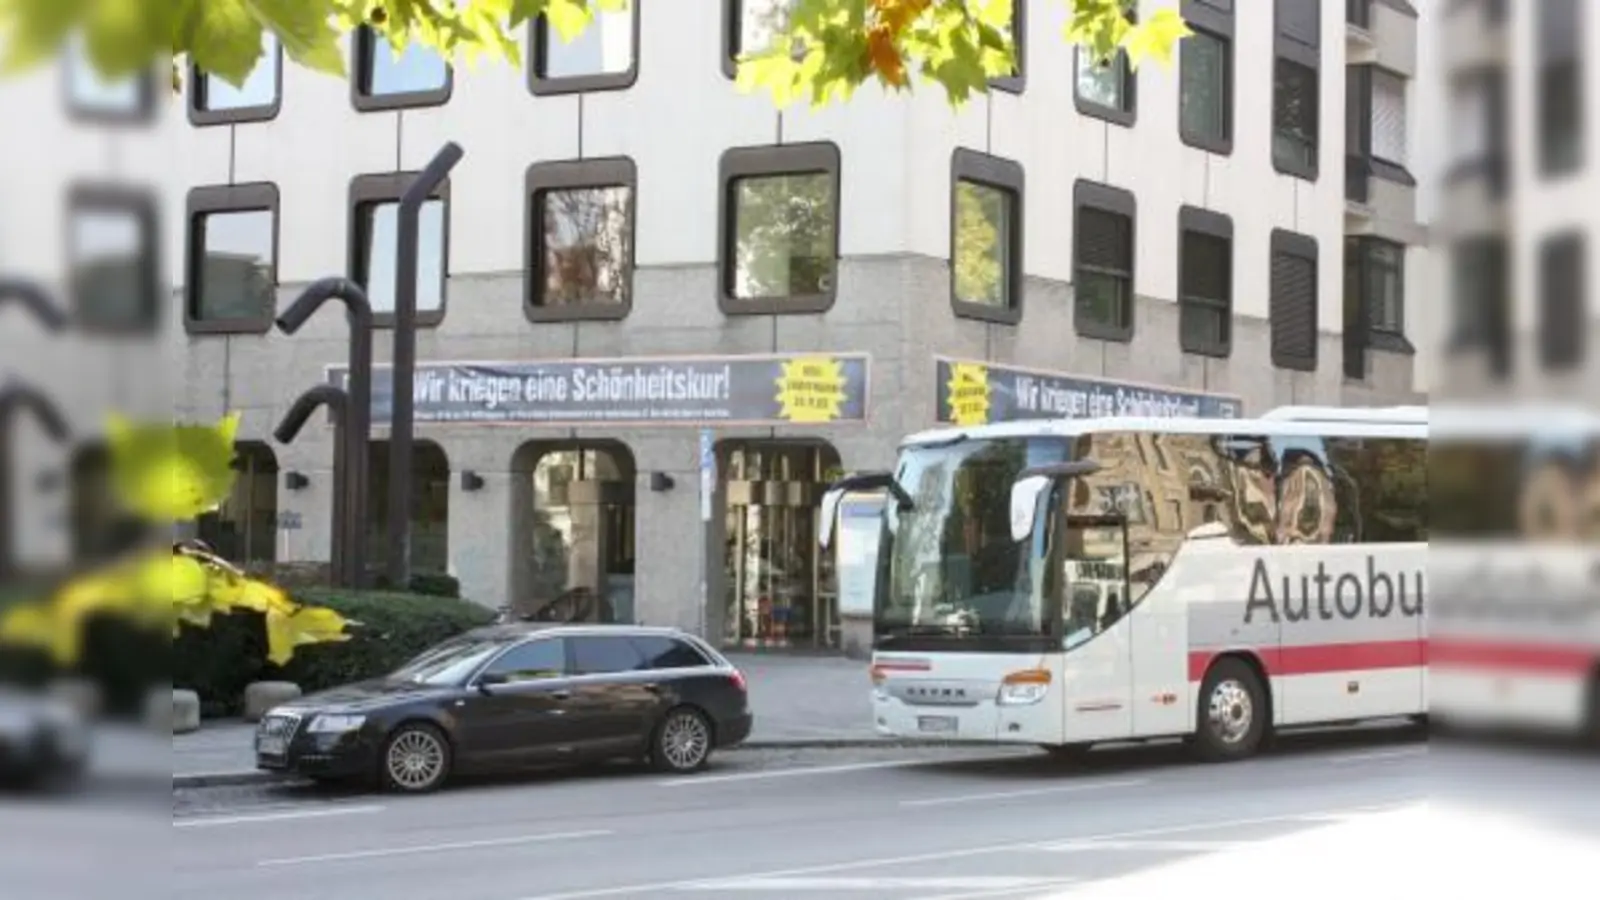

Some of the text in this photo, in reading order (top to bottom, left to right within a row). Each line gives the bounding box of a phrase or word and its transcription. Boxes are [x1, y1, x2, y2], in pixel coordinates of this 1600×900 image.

[448, 370, 521, 408] kriegen
[525, 369, 567, 402] eine
[573, 365, 731, 402] Schönheitskur!
[1016, 376, 1039, 411] Wir
[1041, 379, 1087, 417] kriegen
[1089, 385, 1114, 417] eine
[1243, 555, 1424, 624] Autobu
